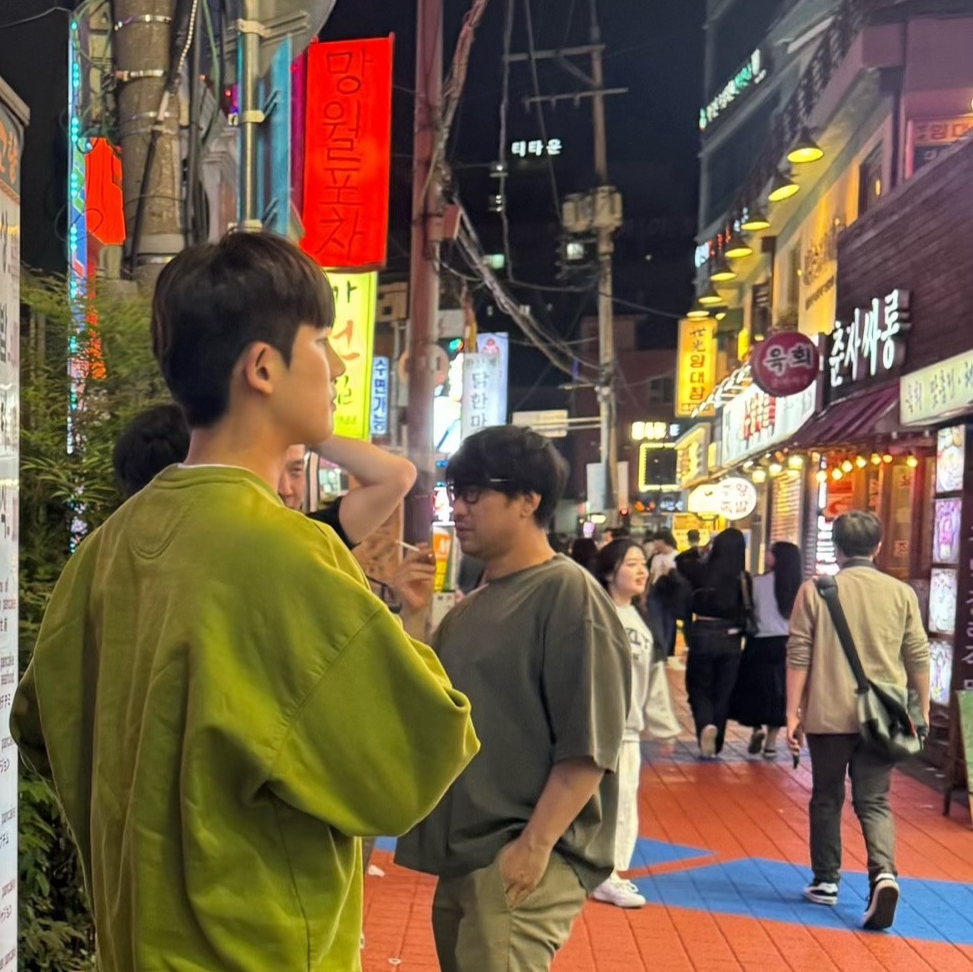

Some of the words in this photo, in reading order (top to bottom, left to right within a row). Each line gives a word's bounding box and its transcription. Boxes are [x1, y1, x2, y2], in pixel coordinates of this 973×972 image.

[511, 138, 562, 157] 티타운
[829, 289, 900, 387] 춘자싸롱
[373, 358, 389, 431] 수면가능
